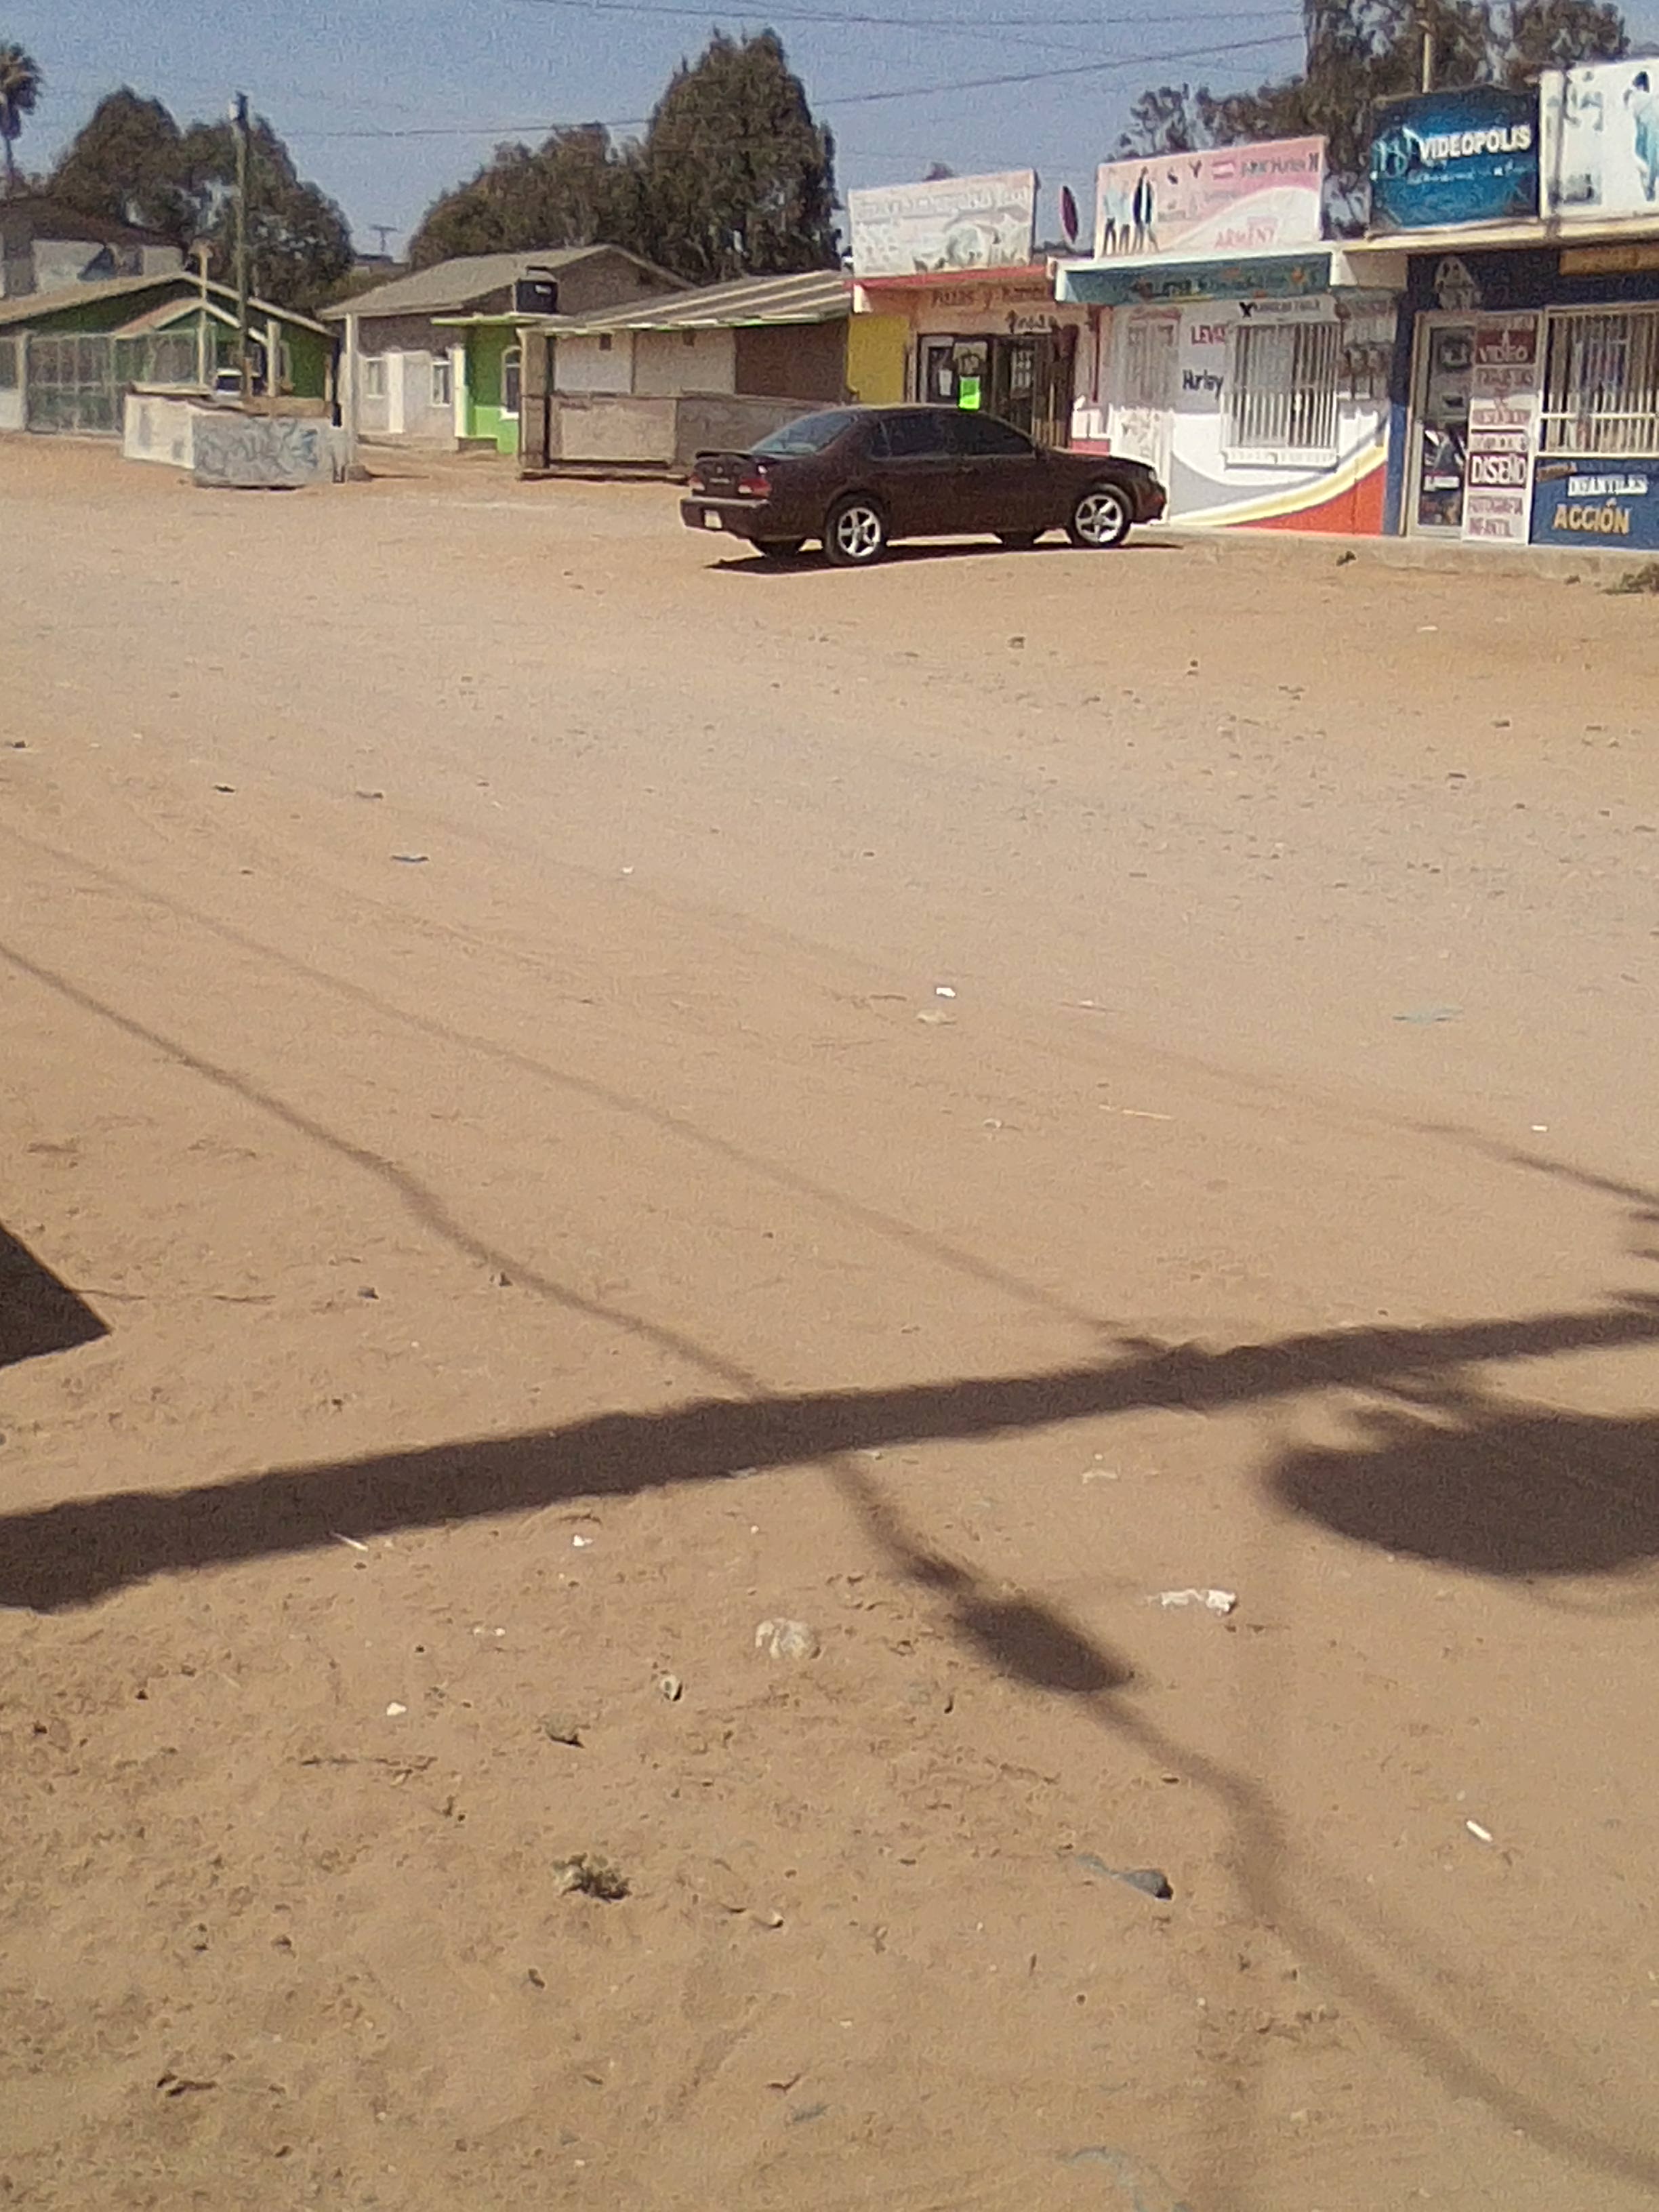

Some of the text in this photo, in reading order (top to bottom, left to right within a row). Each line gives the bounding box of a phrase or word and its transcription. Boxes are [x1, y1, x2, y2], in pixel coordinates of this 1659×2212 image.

[1420, 123, 1532, 160] VIDEOPOLIS
[1182, 369, 1224, 401] Hurley
[1551, 497, 1633, 535] ACCIÓN
